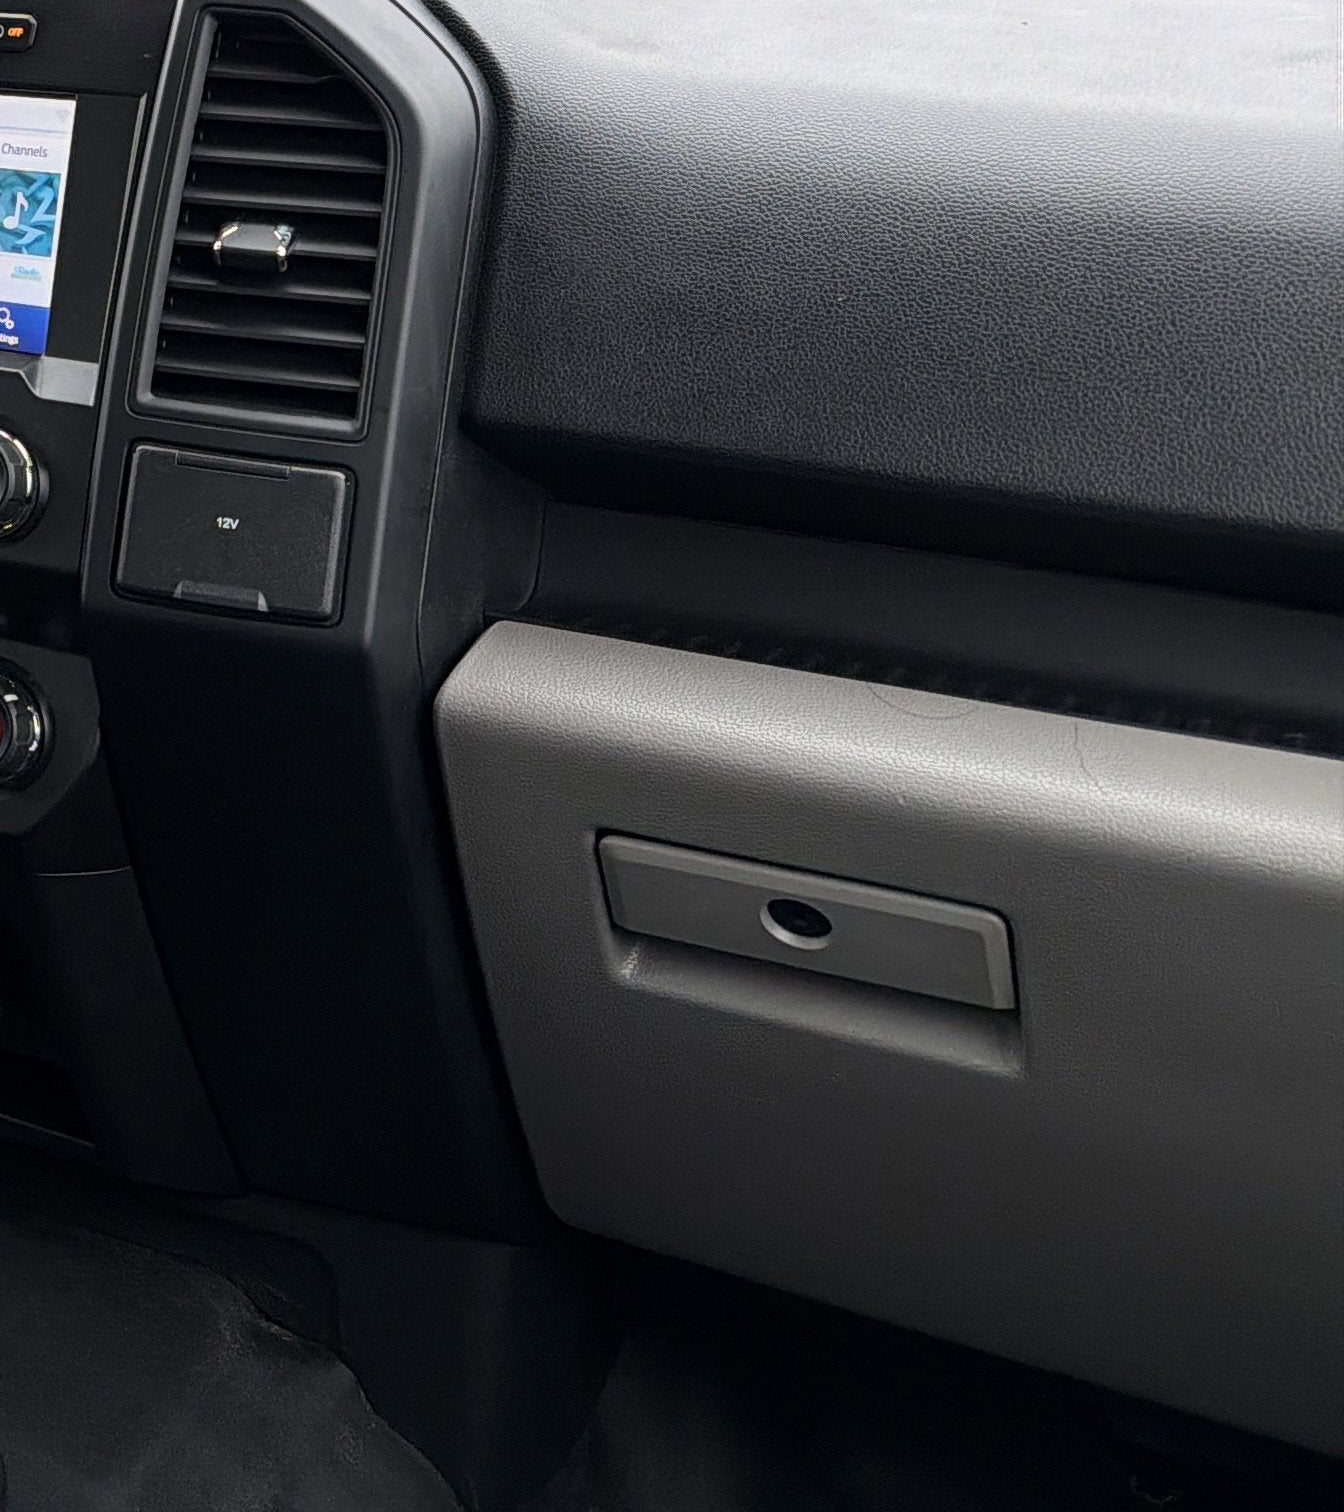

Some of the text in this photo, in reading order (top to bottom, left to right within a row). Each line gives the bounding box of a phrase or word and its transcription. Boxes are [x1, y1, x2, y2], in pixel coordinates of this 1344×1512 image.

[7, 26, 25, 38] OFF
[0, 142, 49, 158] Channels
[216, 516, 240, 530] 12V
